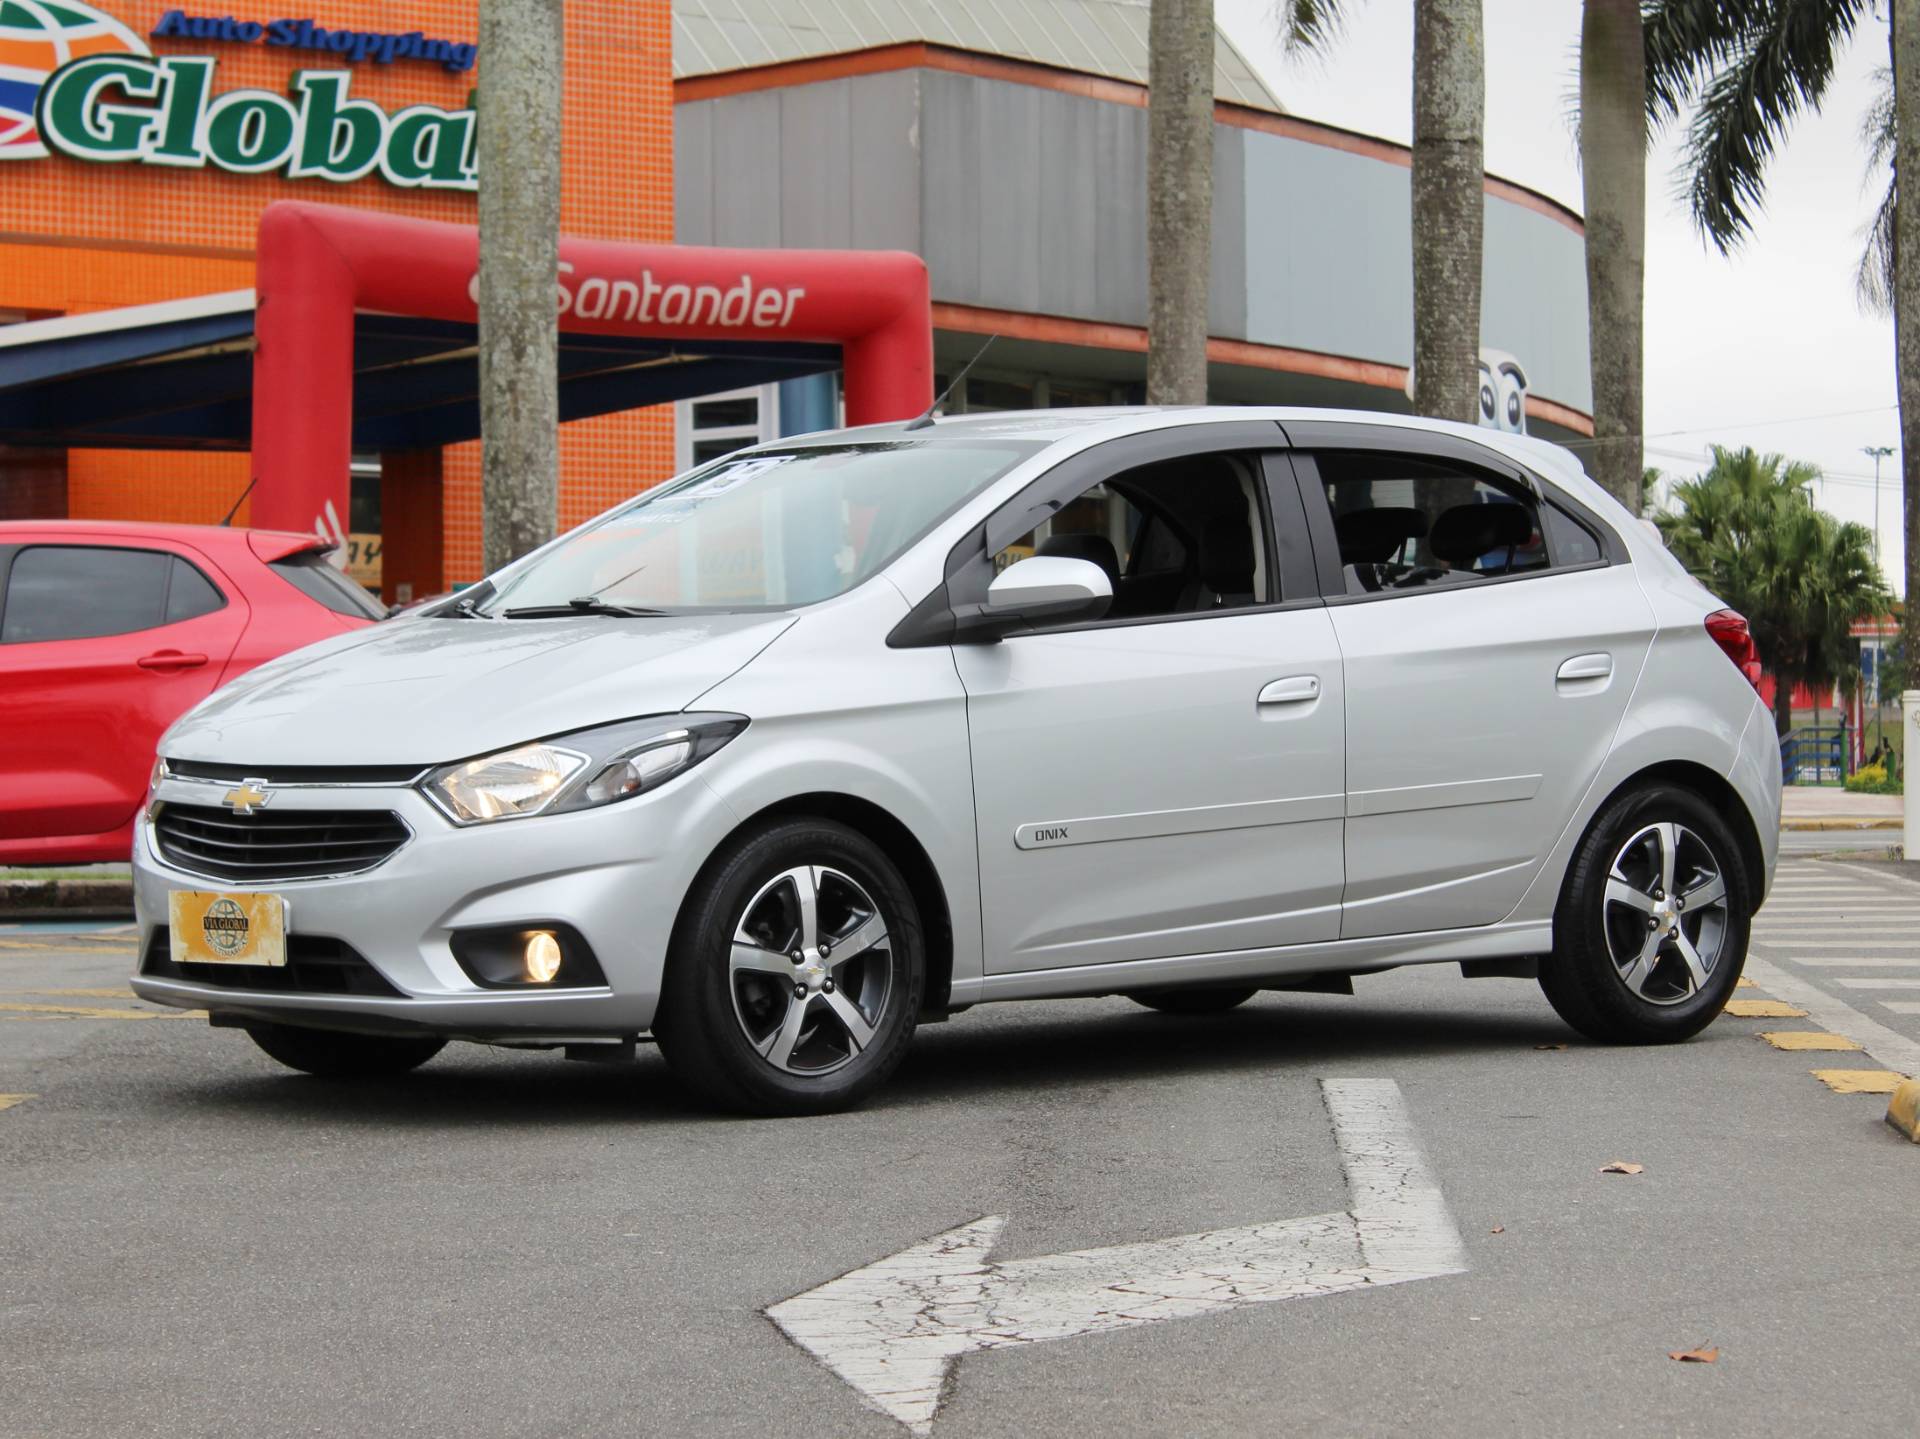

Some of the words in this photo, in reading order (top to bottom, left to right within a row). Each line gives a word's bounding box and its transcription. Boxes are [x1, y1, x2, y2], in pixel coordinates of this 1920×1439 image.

[152, 9, 262, 44] Auto
[267, 18, 478, 72] Shopping
[40, 54, 479, 190] Globa
[1035, 827, 1068, 841] ONIX
